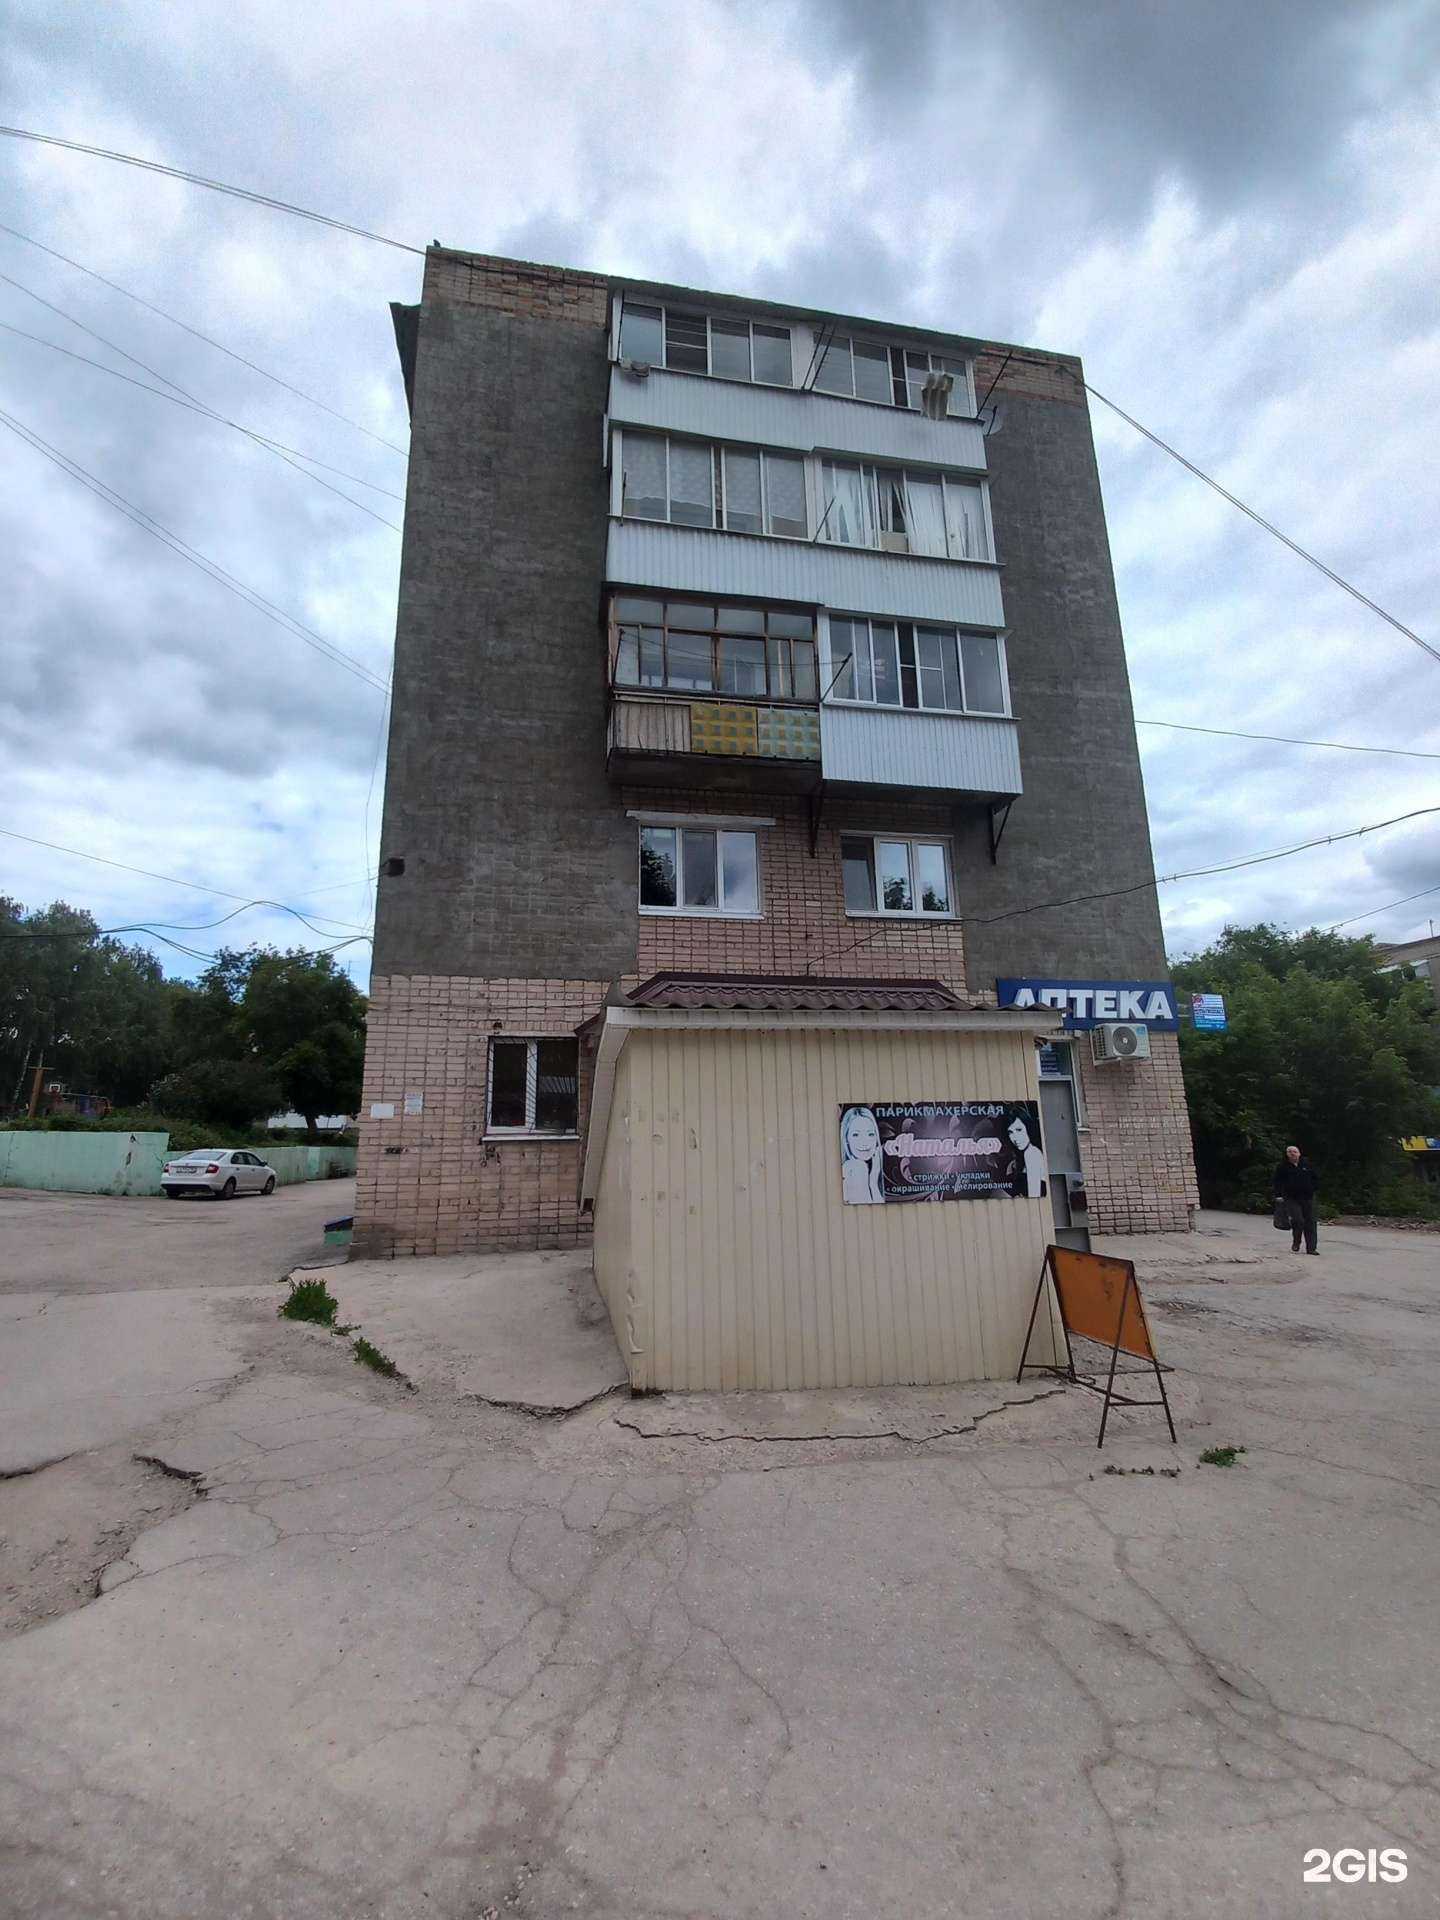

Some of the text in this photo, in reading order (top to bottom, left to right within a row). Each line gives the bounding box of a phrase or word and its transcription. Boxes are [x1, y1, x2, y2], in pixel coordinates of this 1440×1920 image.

[1014, 988, 1173, 1019] АПТЕКА
[876, 1105, 1004, 1117] ПАРИКМАХЕРСКАЯ
[913, 1173, 950, 1182] стрижки
[891, 1184, 950, 1194] окрашивание
